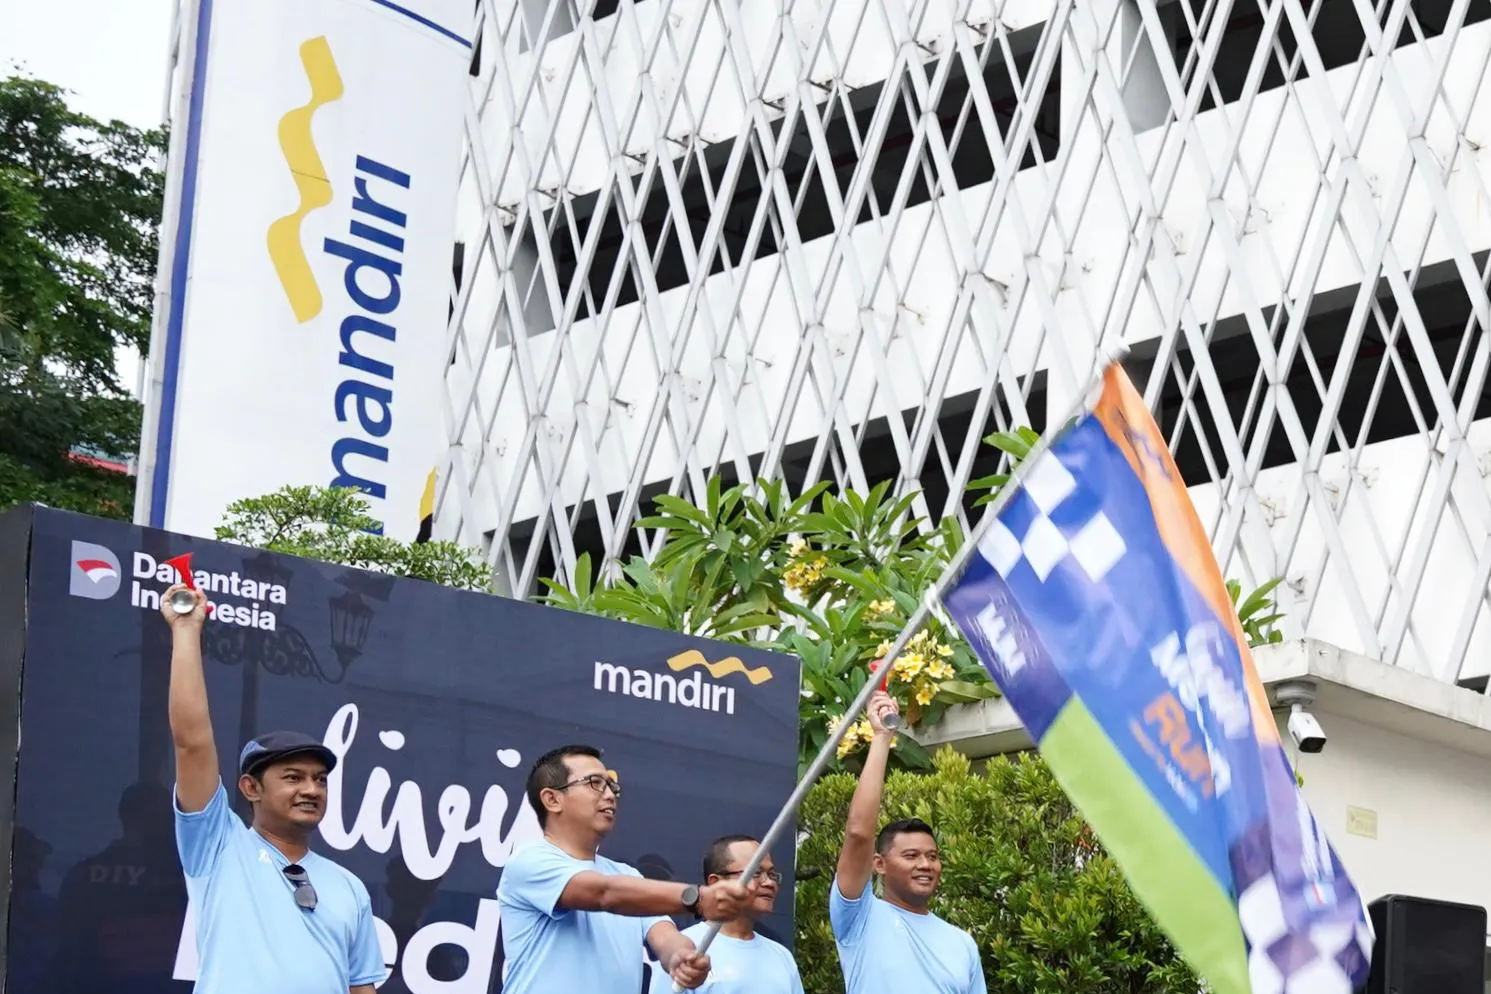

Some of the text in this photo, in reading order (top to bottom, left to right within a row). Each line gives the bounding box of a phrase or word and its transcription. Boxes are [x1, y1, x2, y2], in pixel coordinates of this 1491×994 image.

[323, 154, 411, 536] mandiri
[131, 581, 276, 631] Innesia
[594, 661, 735, 715] mandiri
